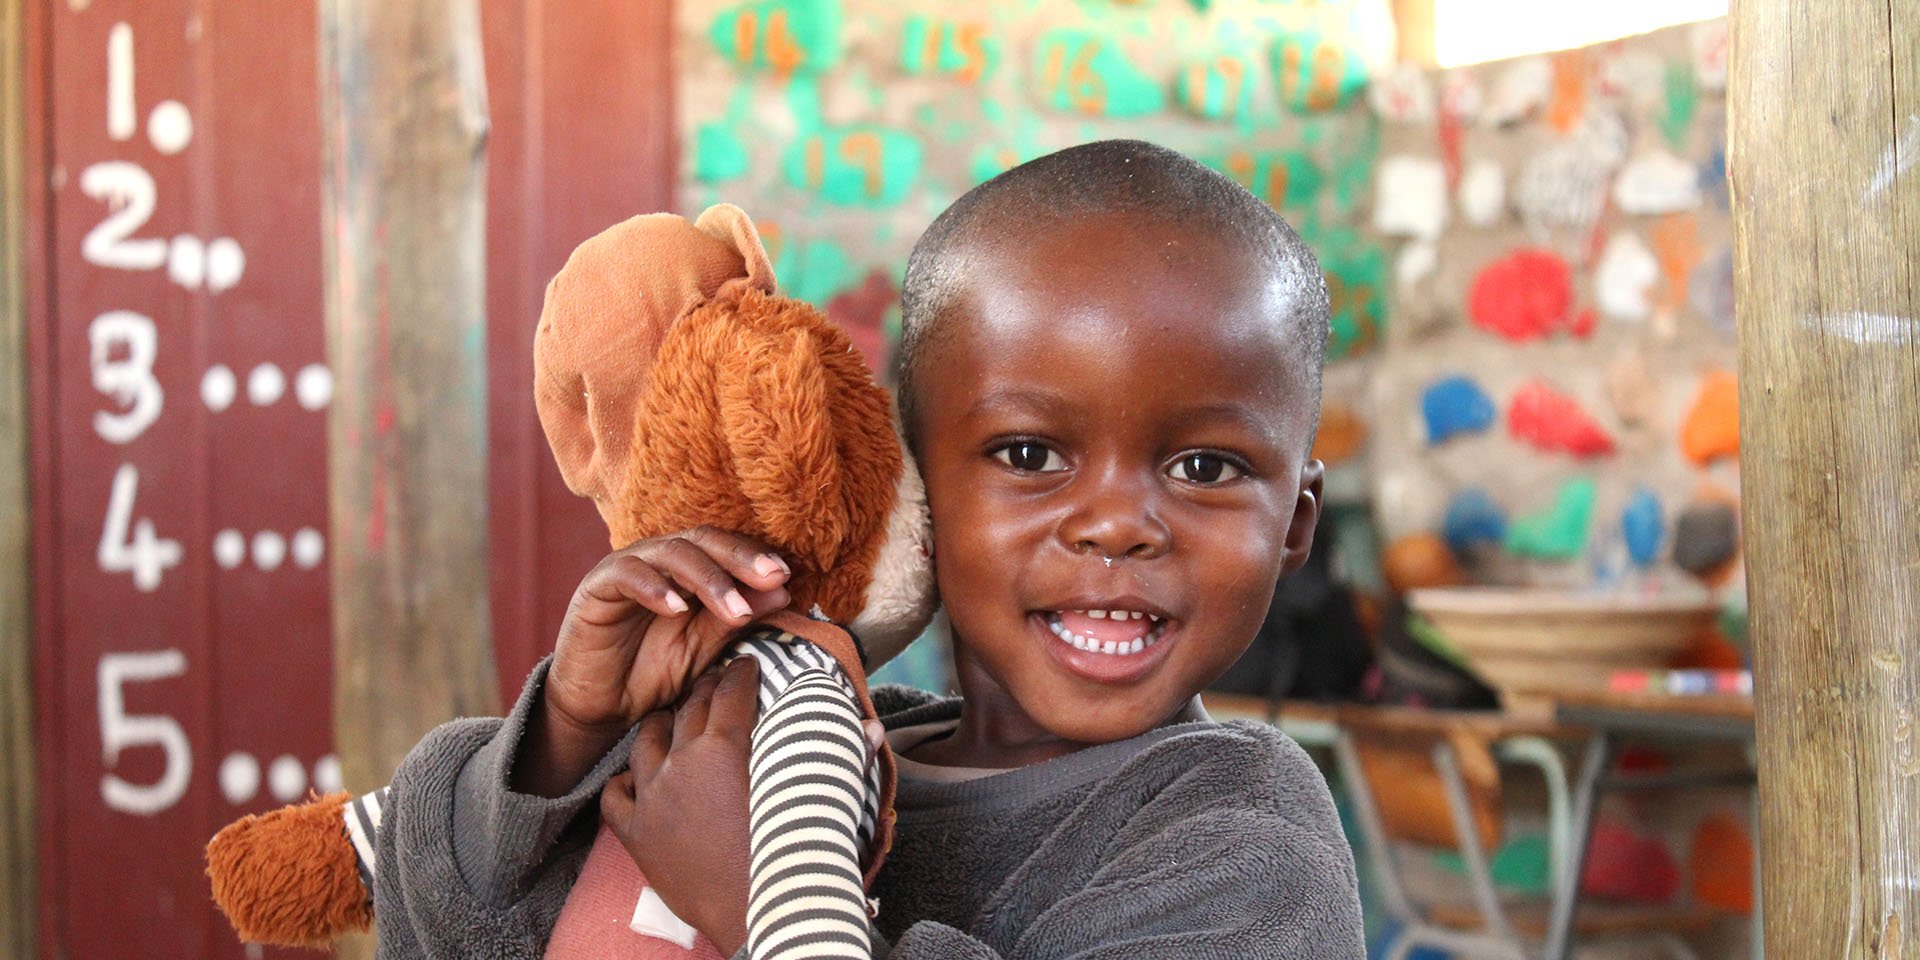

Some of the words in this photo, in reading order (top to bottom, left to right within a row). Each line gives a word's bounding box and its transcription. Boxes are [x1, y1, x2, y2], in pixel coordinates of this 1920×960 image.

[922, 22, 986, 84] 15
[1046, 40, 1108, 116] 16
[1188, 56, 1245, 118] 17
[805, 132, 884, 199] 19
